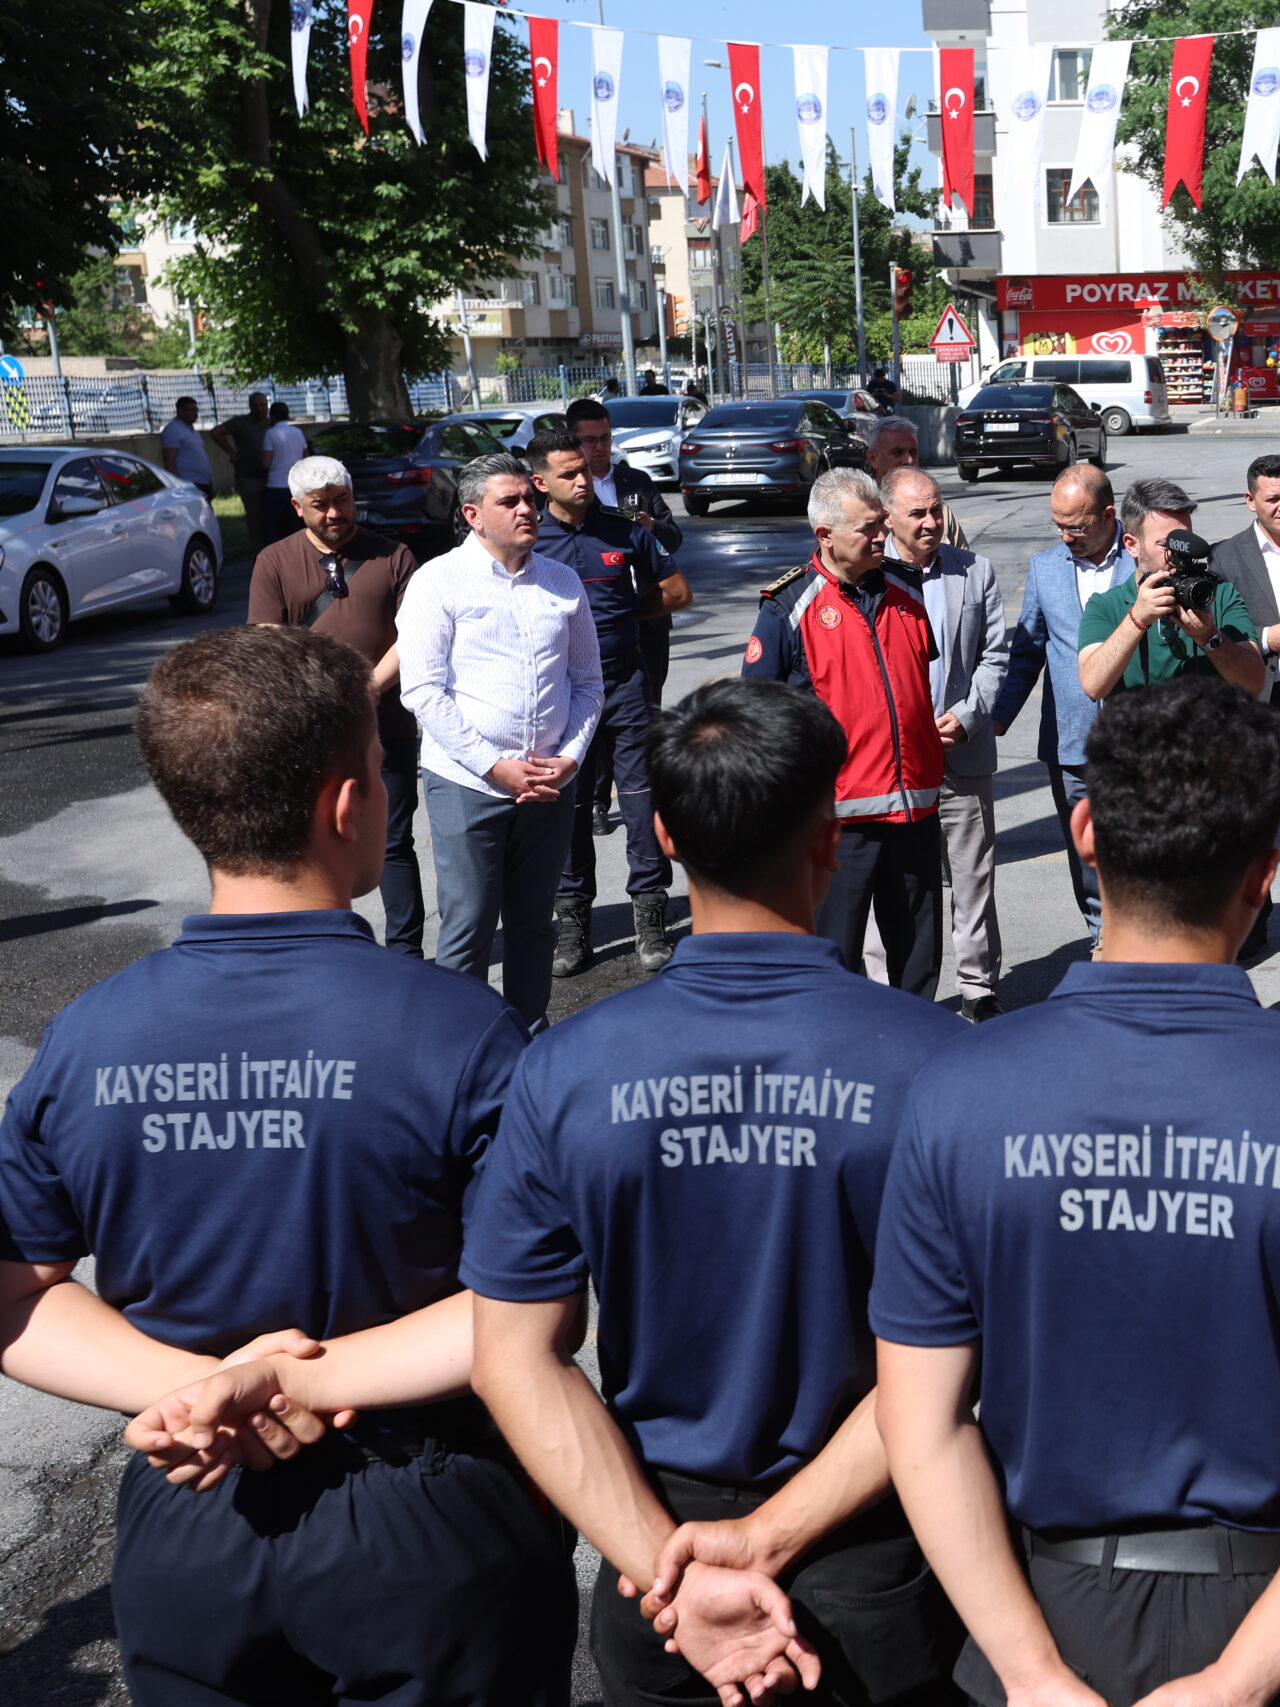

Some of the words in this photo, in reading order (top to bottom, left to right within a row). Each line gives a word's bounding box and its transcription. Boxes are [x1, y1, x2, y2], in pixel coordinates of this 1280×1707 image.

[1065, 283, 1169, 303] POYRAZ
[1169, 538, 1190, 553] RØDE
[95, 1052, 229, 1107] KAYSERİ
[240, 1049, 356, 1100] İTFAİYE
[611, 1065, 744, 1124] KAYSERİ
[754, 1067, 875, 1124] İTFAİYE
[142, 1109, 306, 1153] STAJYER
[660, 1124, 817, 1168] STAJYER
[1004, 1124, 1151, 1179] KAYSERİ
[1059, 1188, 1235, 1239] STAJYER
